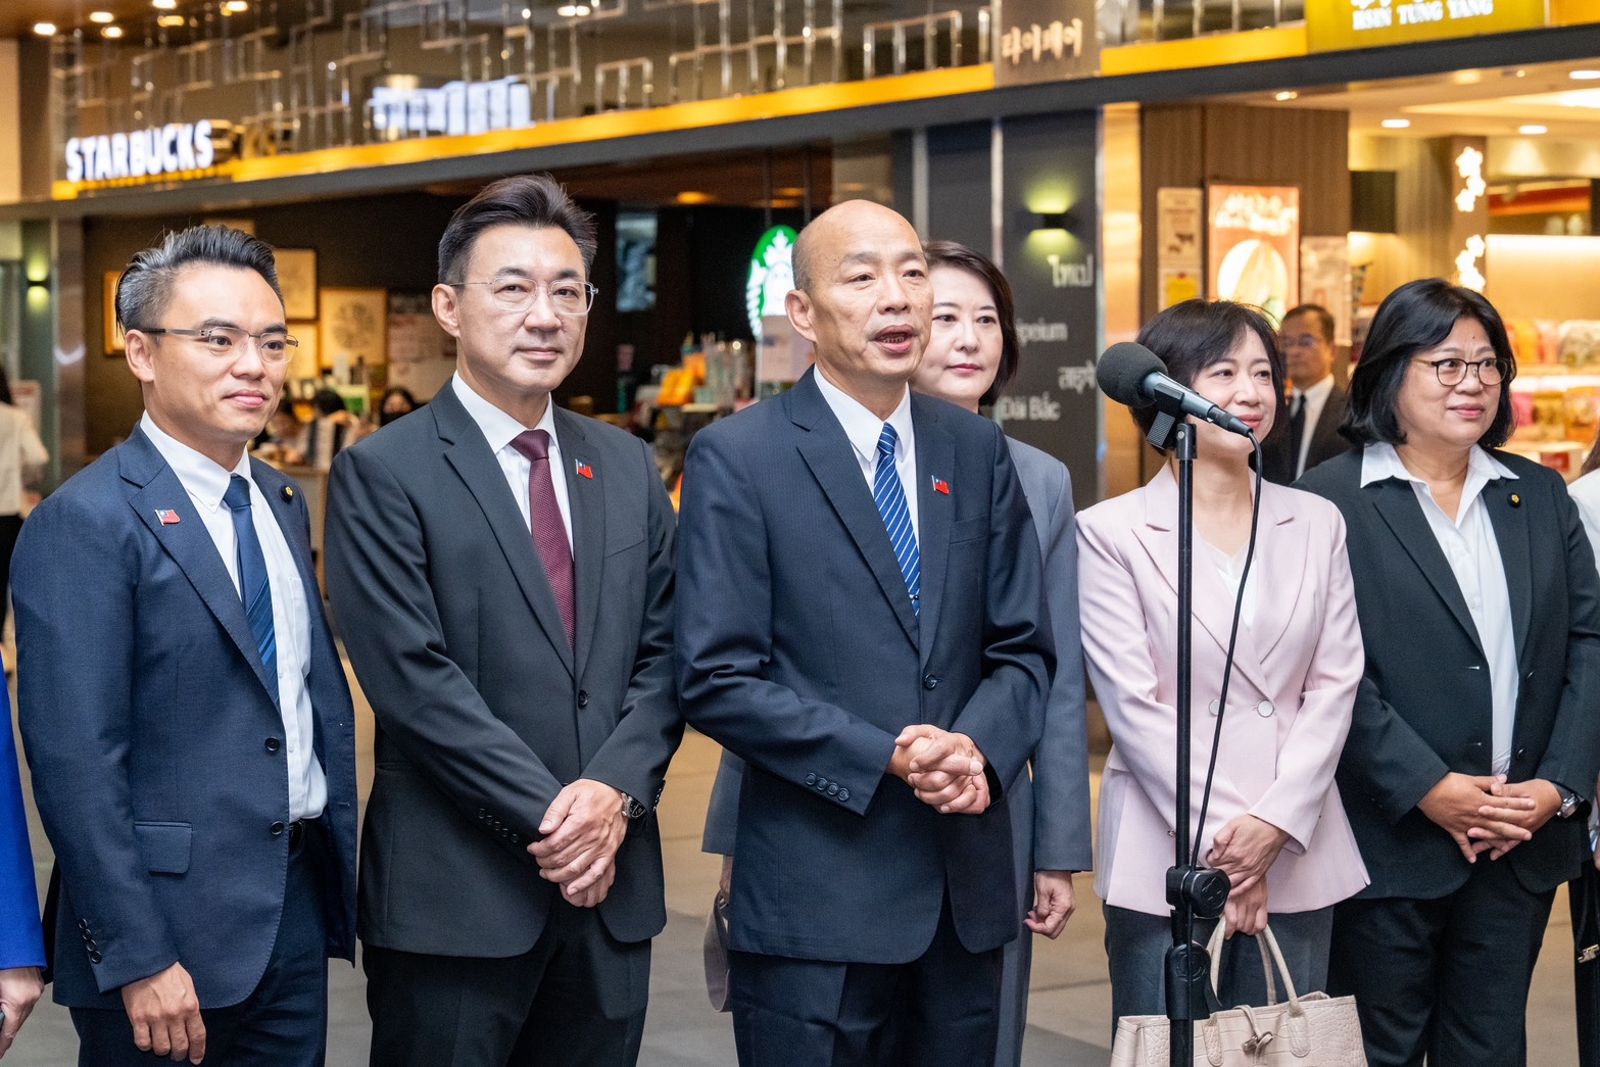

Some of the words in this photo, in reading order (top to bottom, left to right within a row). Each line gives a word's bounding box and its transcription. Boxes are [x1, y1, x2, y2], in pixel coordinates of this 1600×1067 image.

[1397, 2, 1443, 24] TUNG
[1448, 0, 1494, 19] YANG
[65, 119, 214, 183] STARBUCKS
